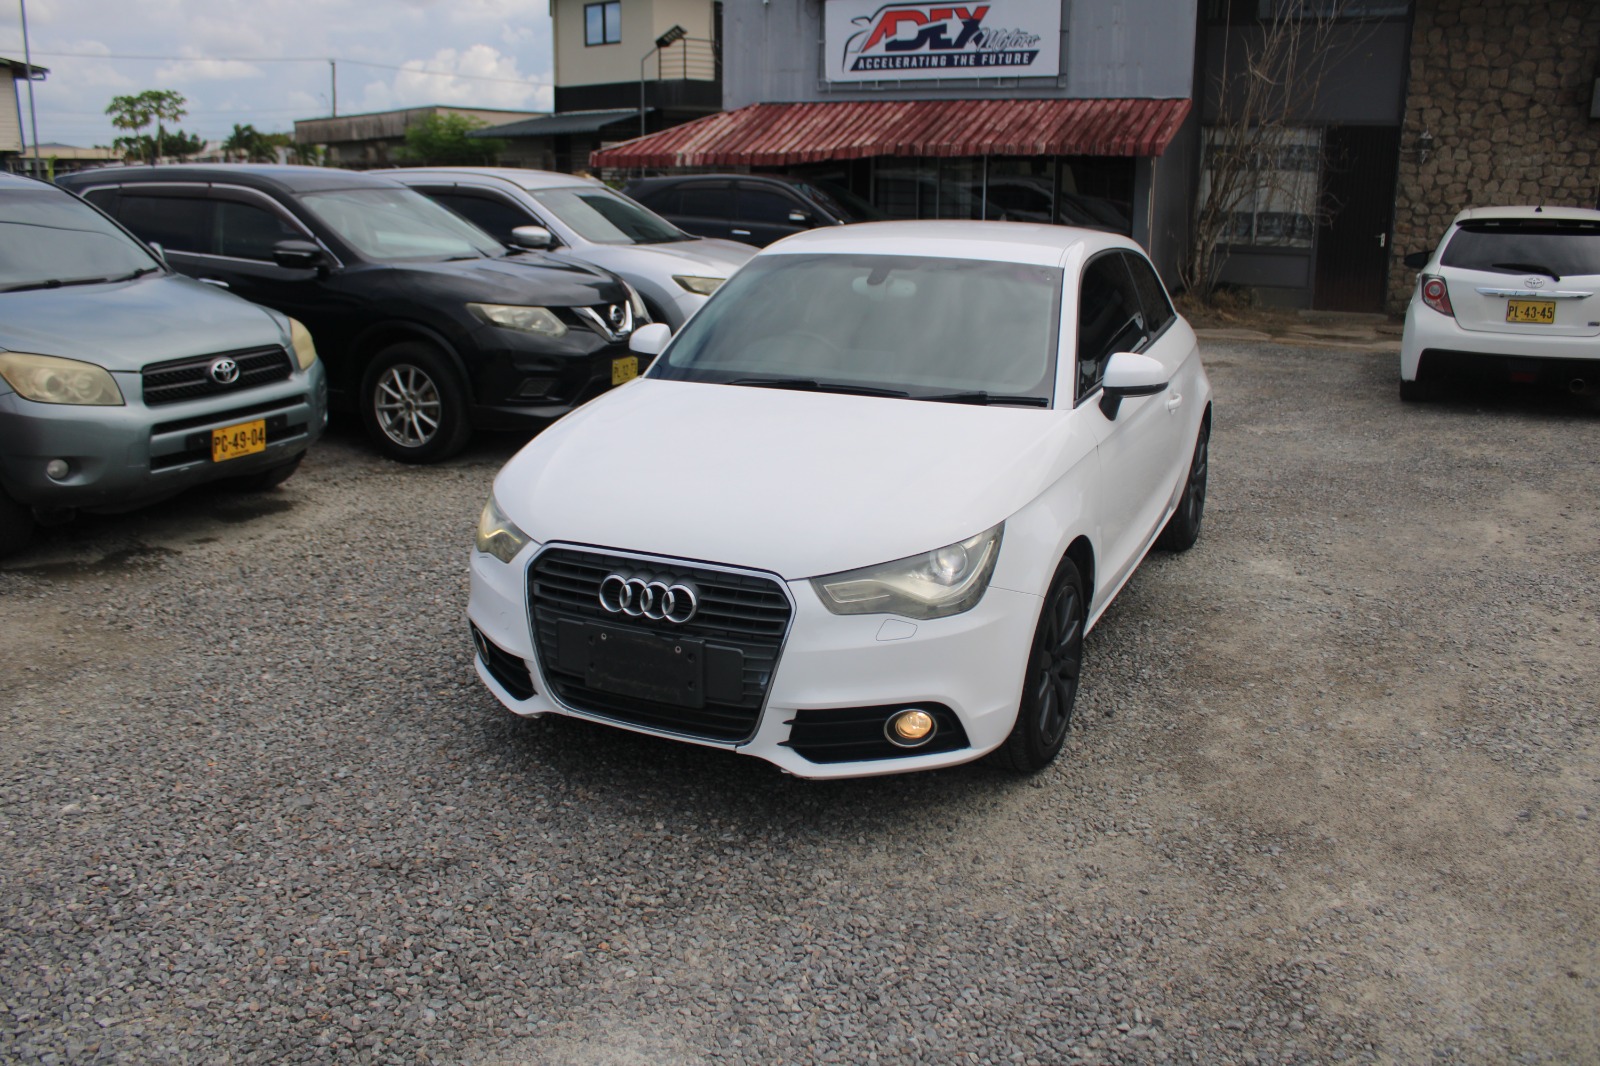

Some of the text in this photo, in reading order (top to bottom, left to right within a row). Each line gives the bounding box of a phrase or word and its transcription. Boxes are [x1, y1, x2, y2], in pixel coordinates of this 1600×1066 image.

[858, 53, 1029, 69] ACCELERATING THE FUTURE
[1508, 306, 1553, 319] PL-43-45
[214, 427, 264, 454] PC-49-04
